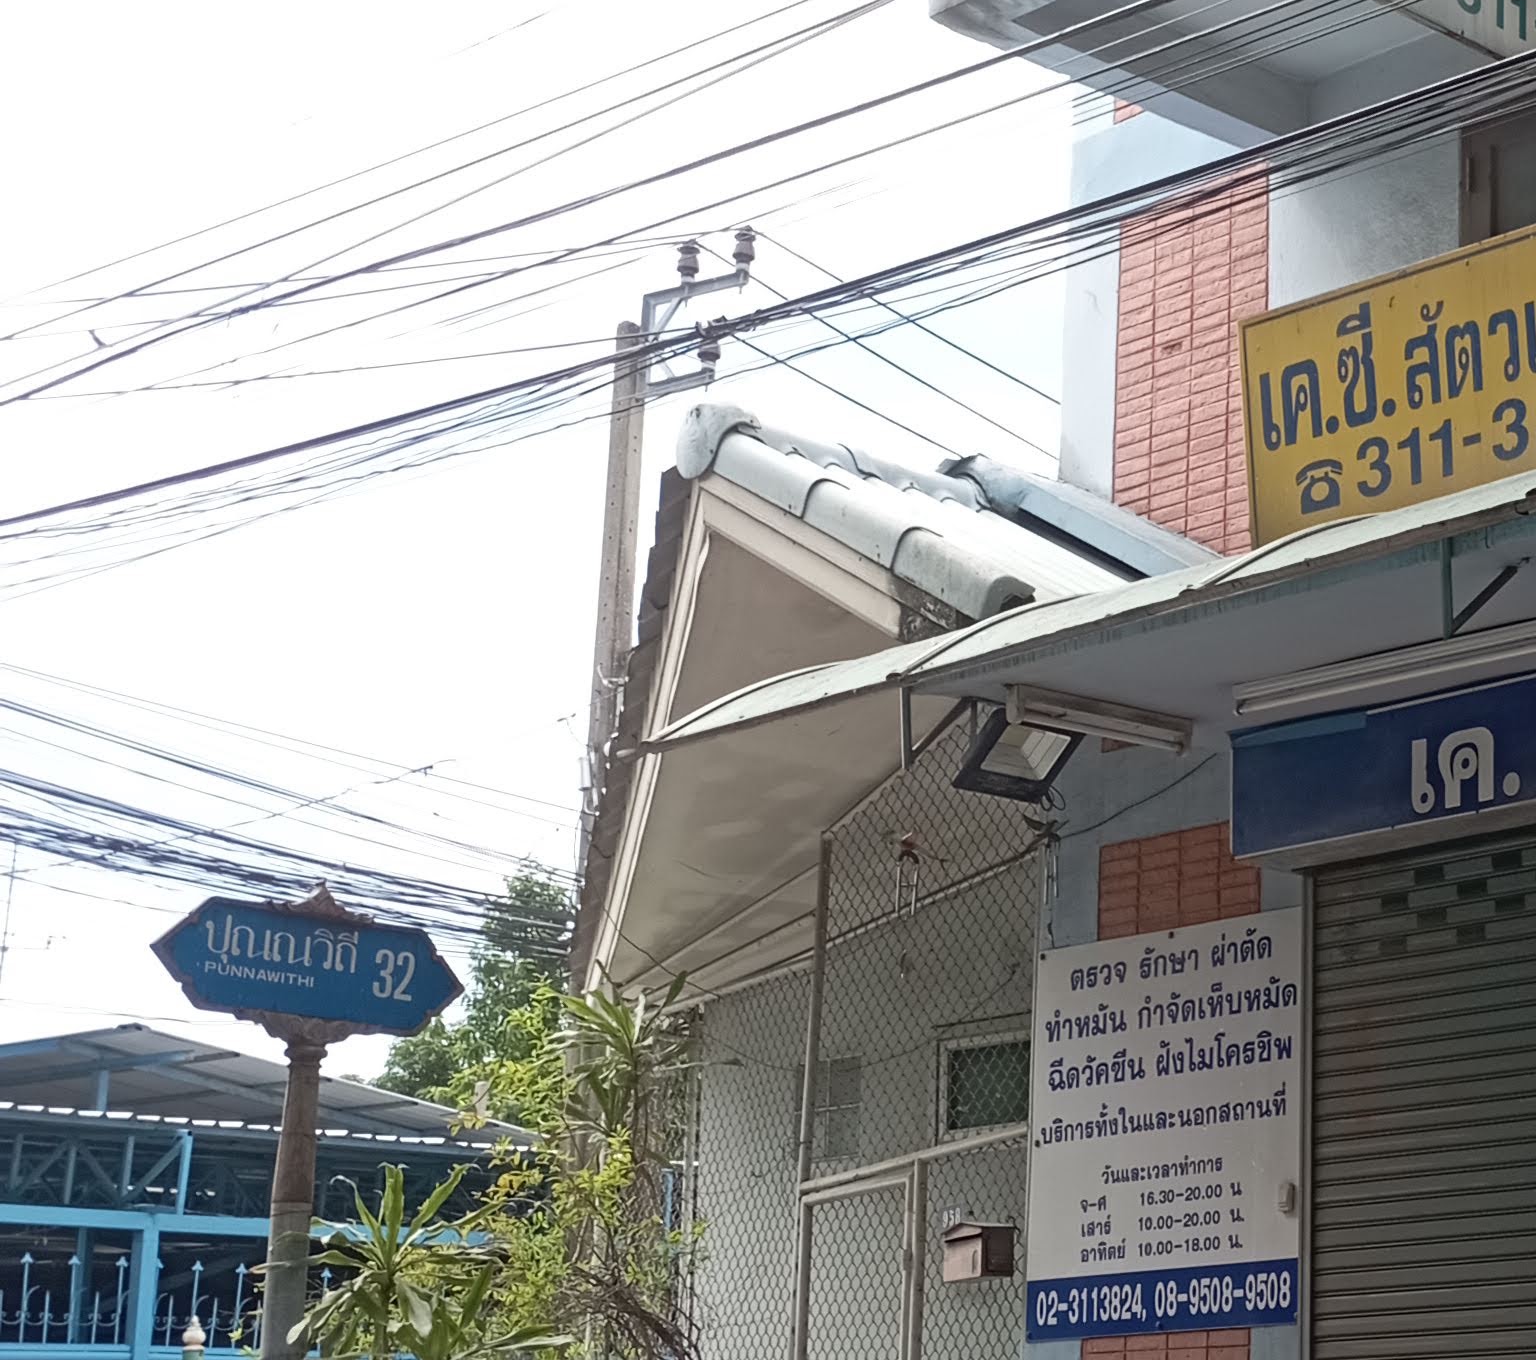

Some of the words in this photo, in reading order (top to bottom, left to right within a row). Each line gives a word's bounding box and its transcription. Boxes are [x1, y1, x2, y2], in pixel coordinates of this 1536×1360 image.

[1411, 726, 1520, 815] เค.
[204, 961, 315, 988] PUNNAWITHI
[205, 914, 359, 974] ปุณณวิถี
[372, 948, 416, 1002] 32
[1070, 961, 1127, 991] ตรวจ
[1139, 947, 1199, 980] รักษา
[1211, 928, 1272, 968] ผ่าตัด
[1045, 1003, 1127, 1043] ทำหมัน
[1137, 976, 1298, 1030] กำจัดเห็บหมัด
[1048, 1048, 1146, 1092] ฉีดวัคซีน
[1156, 1030, 1293, 1077] ฝังไมโครชิพ
[1041, 1081, 1287, 1145] บริการทั้งในและนอกสถานที่
[1080, 1195, 1107, 1213] จ-ศ
[1140, 1184, 1222, 1207] 16.30-20.00
[1230, 1181, 1242, 1196] น
[1101, 1154, 1223, 1184] วันและเวลาทำการ
[1080, 1238, 1126, 1262] อาทิตย์
[1138, 1236, 1221, 1257] 10.00-18.00
[1228, 1234, 1243, 1249] น.
[1081, 1214, 1111, 1237] เสาร์
[1138, 1210, 1221, 1231] 10.00-20.00
[1230, 1207, 1245, 1223] น.
[1036, 1283, 1147, 1326] 02-3113824,
[1154, 1271, 1292, 1317] 08-9508-9508
